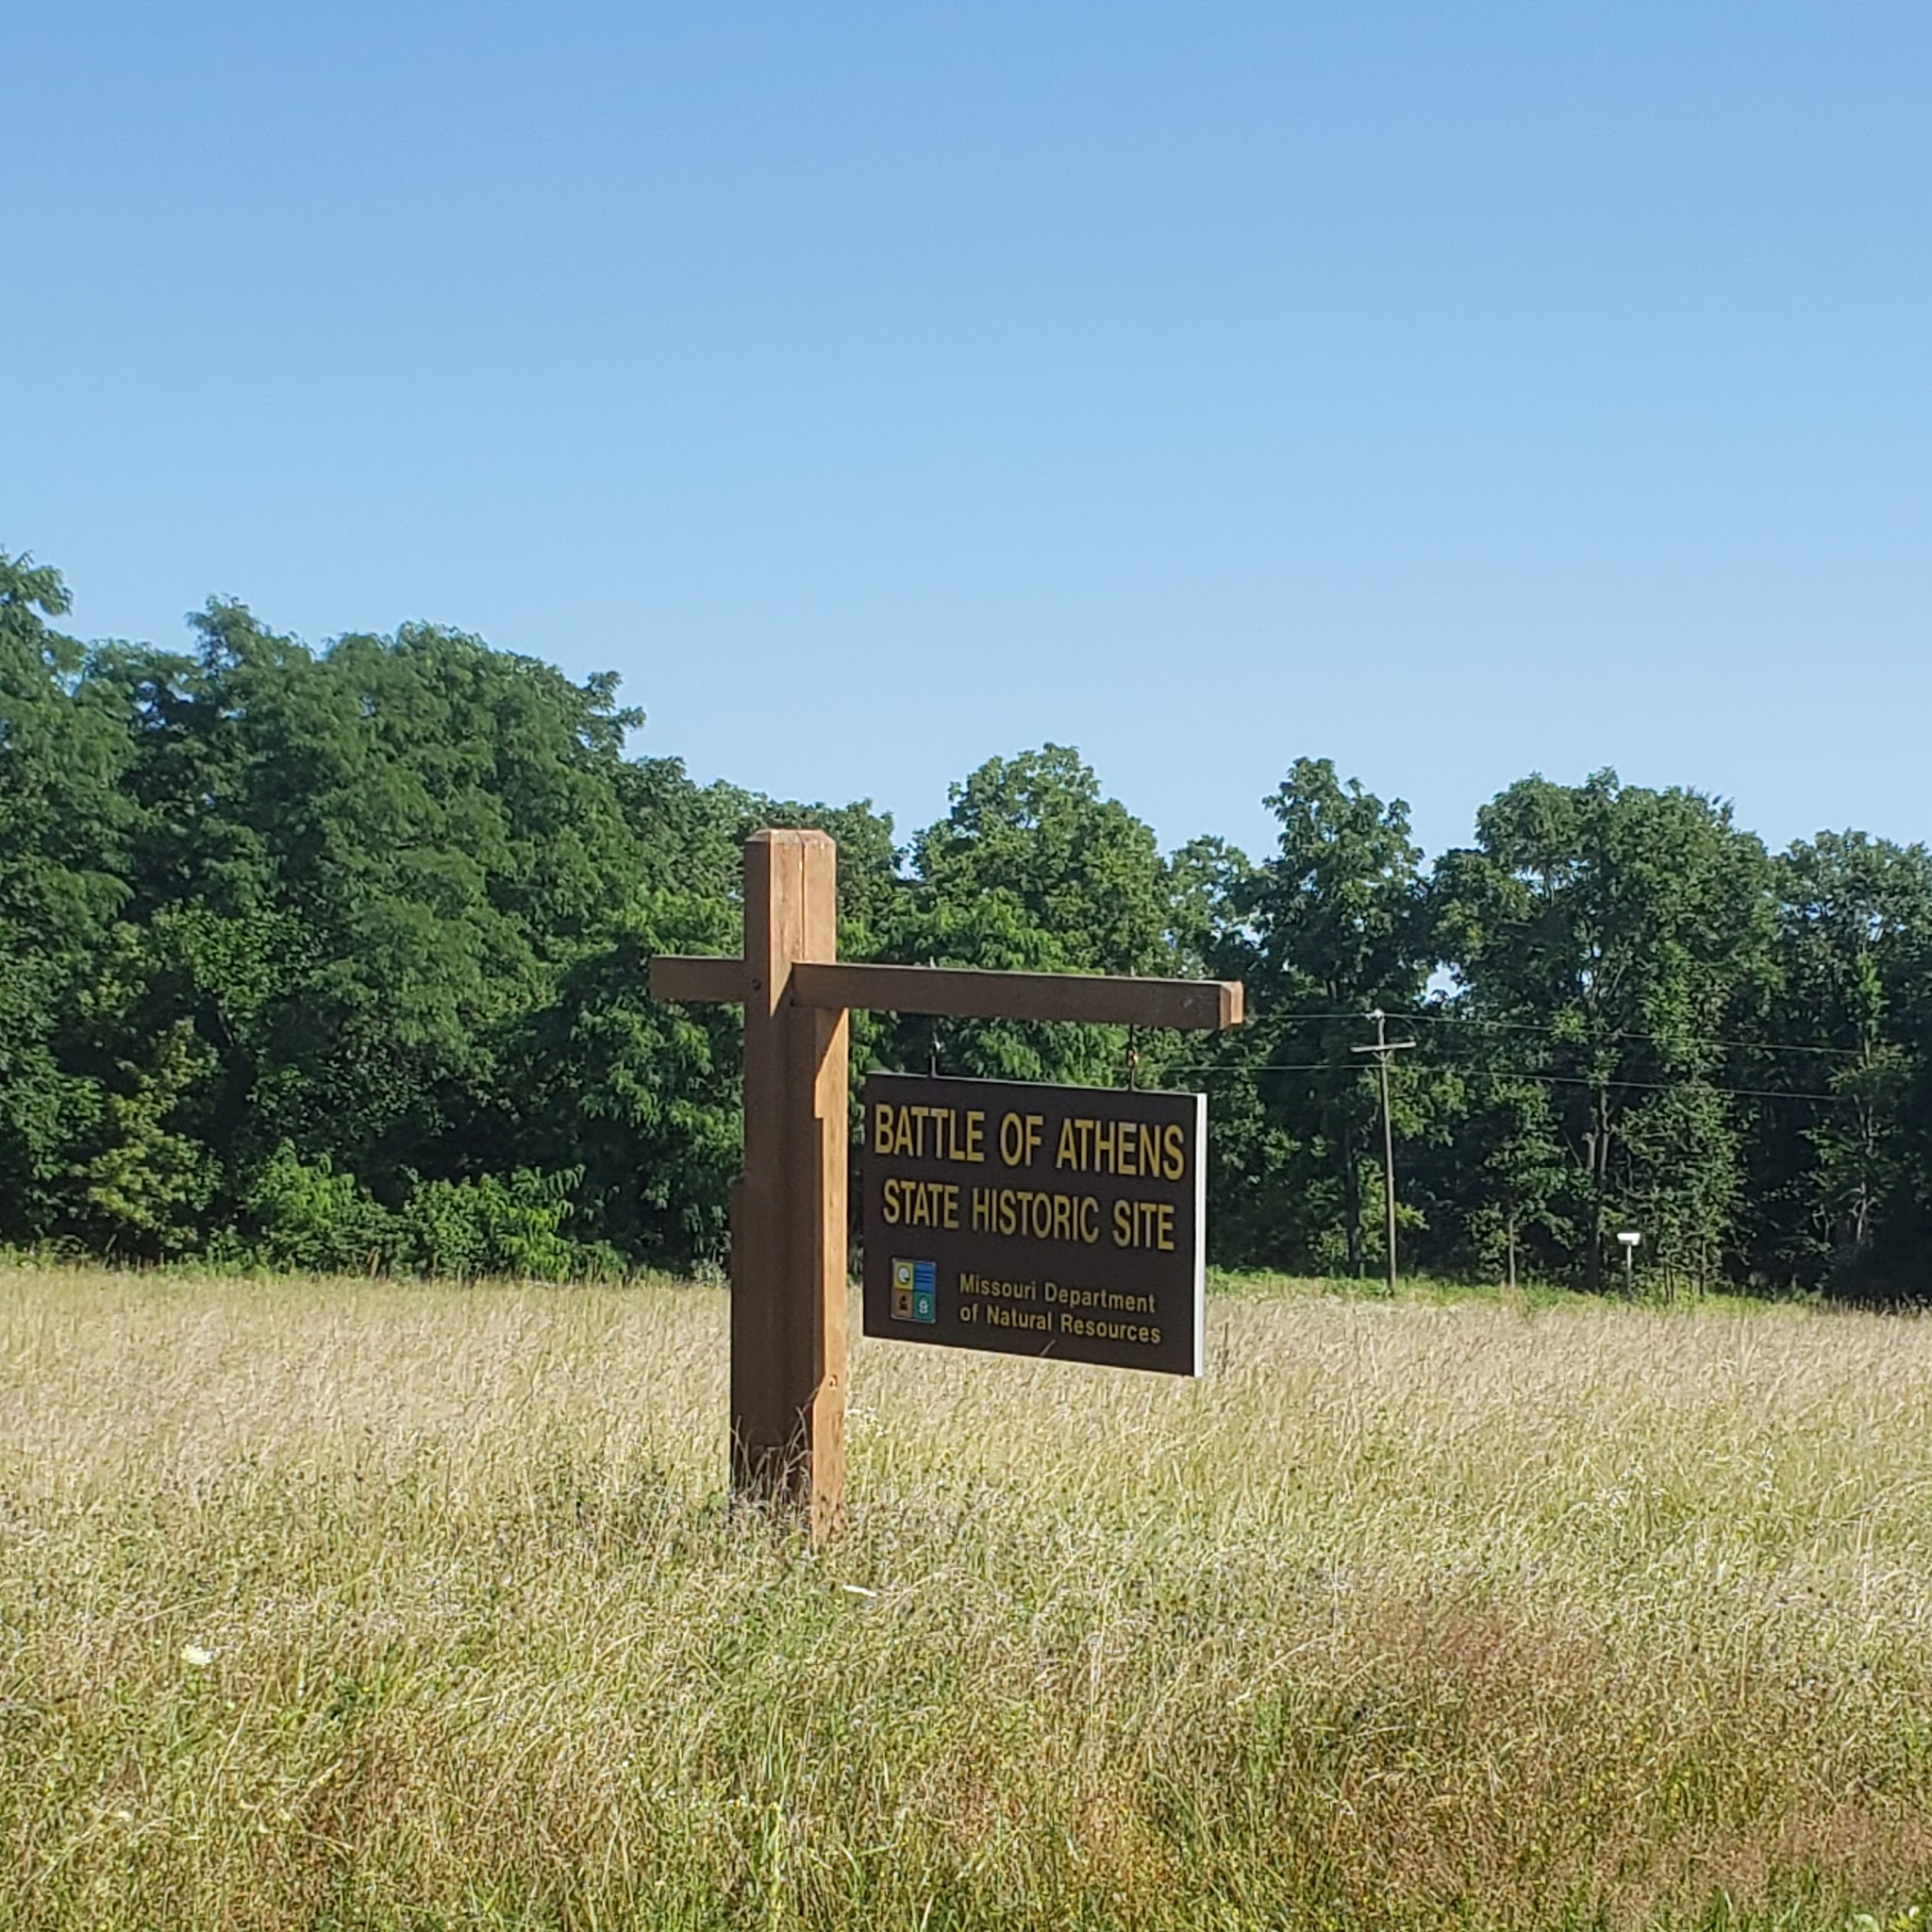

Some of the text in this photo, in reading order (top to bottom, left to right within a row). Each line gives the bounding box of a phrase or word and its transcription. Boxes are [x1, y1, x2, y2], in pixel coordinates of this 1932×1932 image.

[874, 1104, 1185, 1180] BATTLE OF ATHENS
[883, 1178, 1175, 1251] STATE HISTORIC SITE
[959, 1274, 1156, 1314] Missouri Department
[959, 1304, 1161, 1344] of Natural Resources
